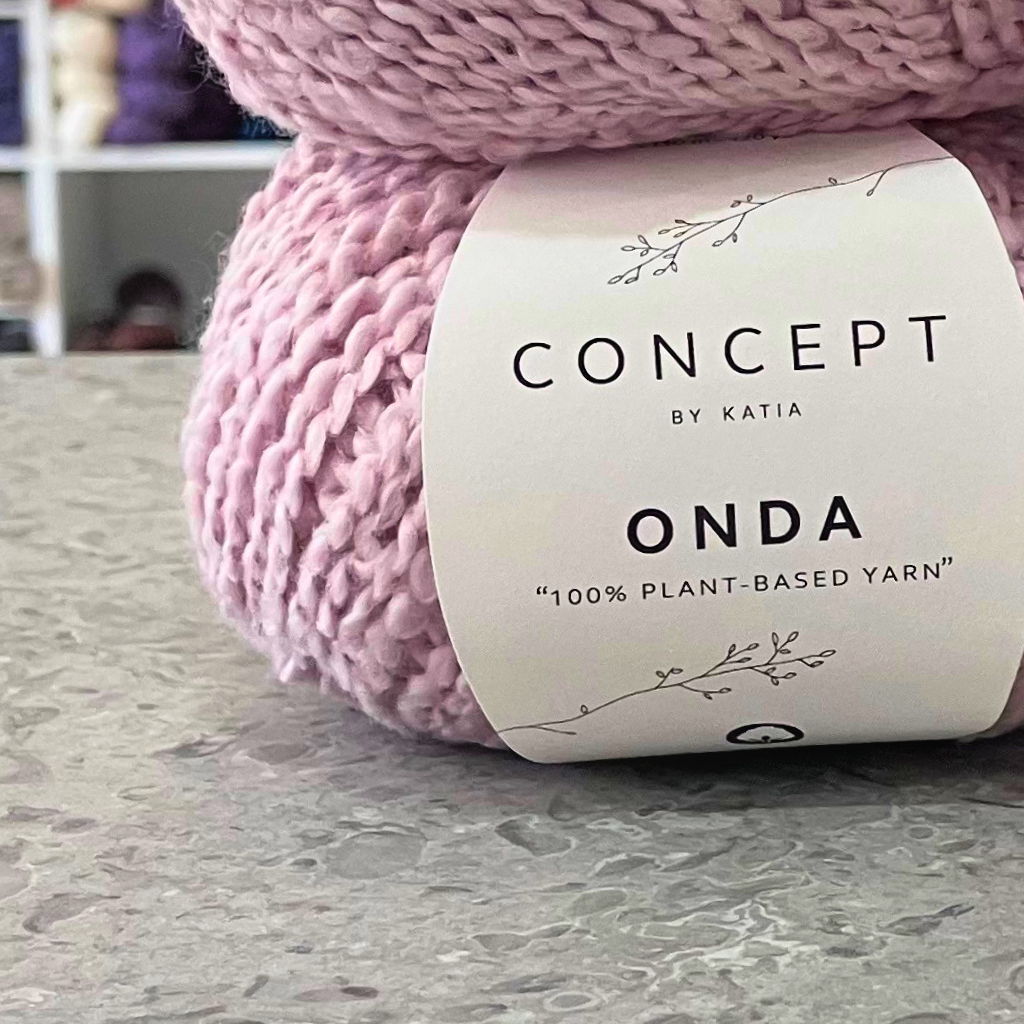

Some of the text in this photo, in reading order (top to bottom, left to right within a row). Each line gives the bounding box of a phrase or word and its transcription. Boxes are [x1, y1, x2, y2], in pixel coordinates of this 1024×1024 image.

[513, 314, 947, 389] CONCEPT
[671, 402, 803, 425] BY KATIA
[626, 495, 863, 555] ONDA
[642, 569, 849, 600] PLANT-BASED
